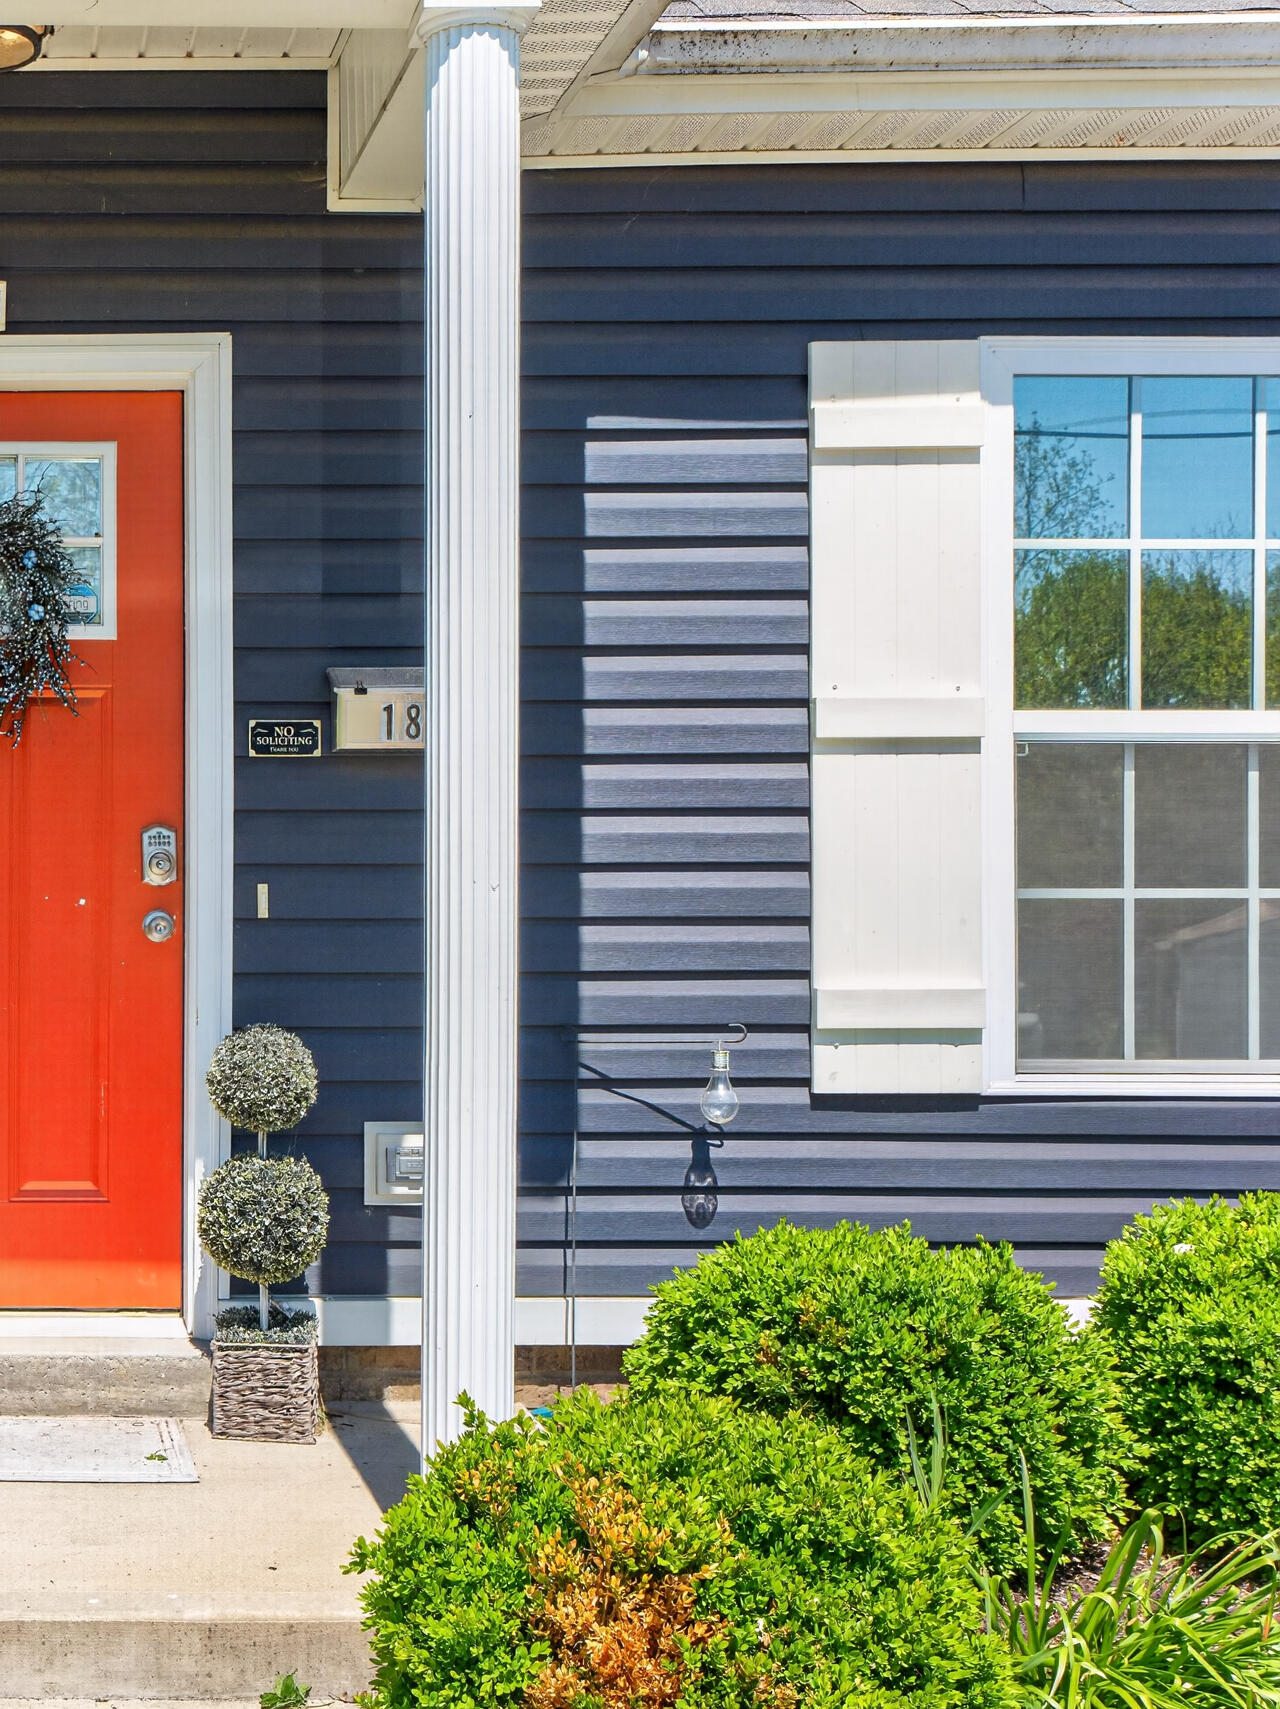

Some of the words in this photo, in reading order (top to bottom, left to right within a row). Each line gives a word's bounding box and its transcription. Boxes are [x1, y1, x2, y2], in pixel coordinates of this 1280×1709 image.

[383, 703, 421, 741] 18
[274, 725, 295, 738] NO
[256, 736, 313, 745] SOLICITING
